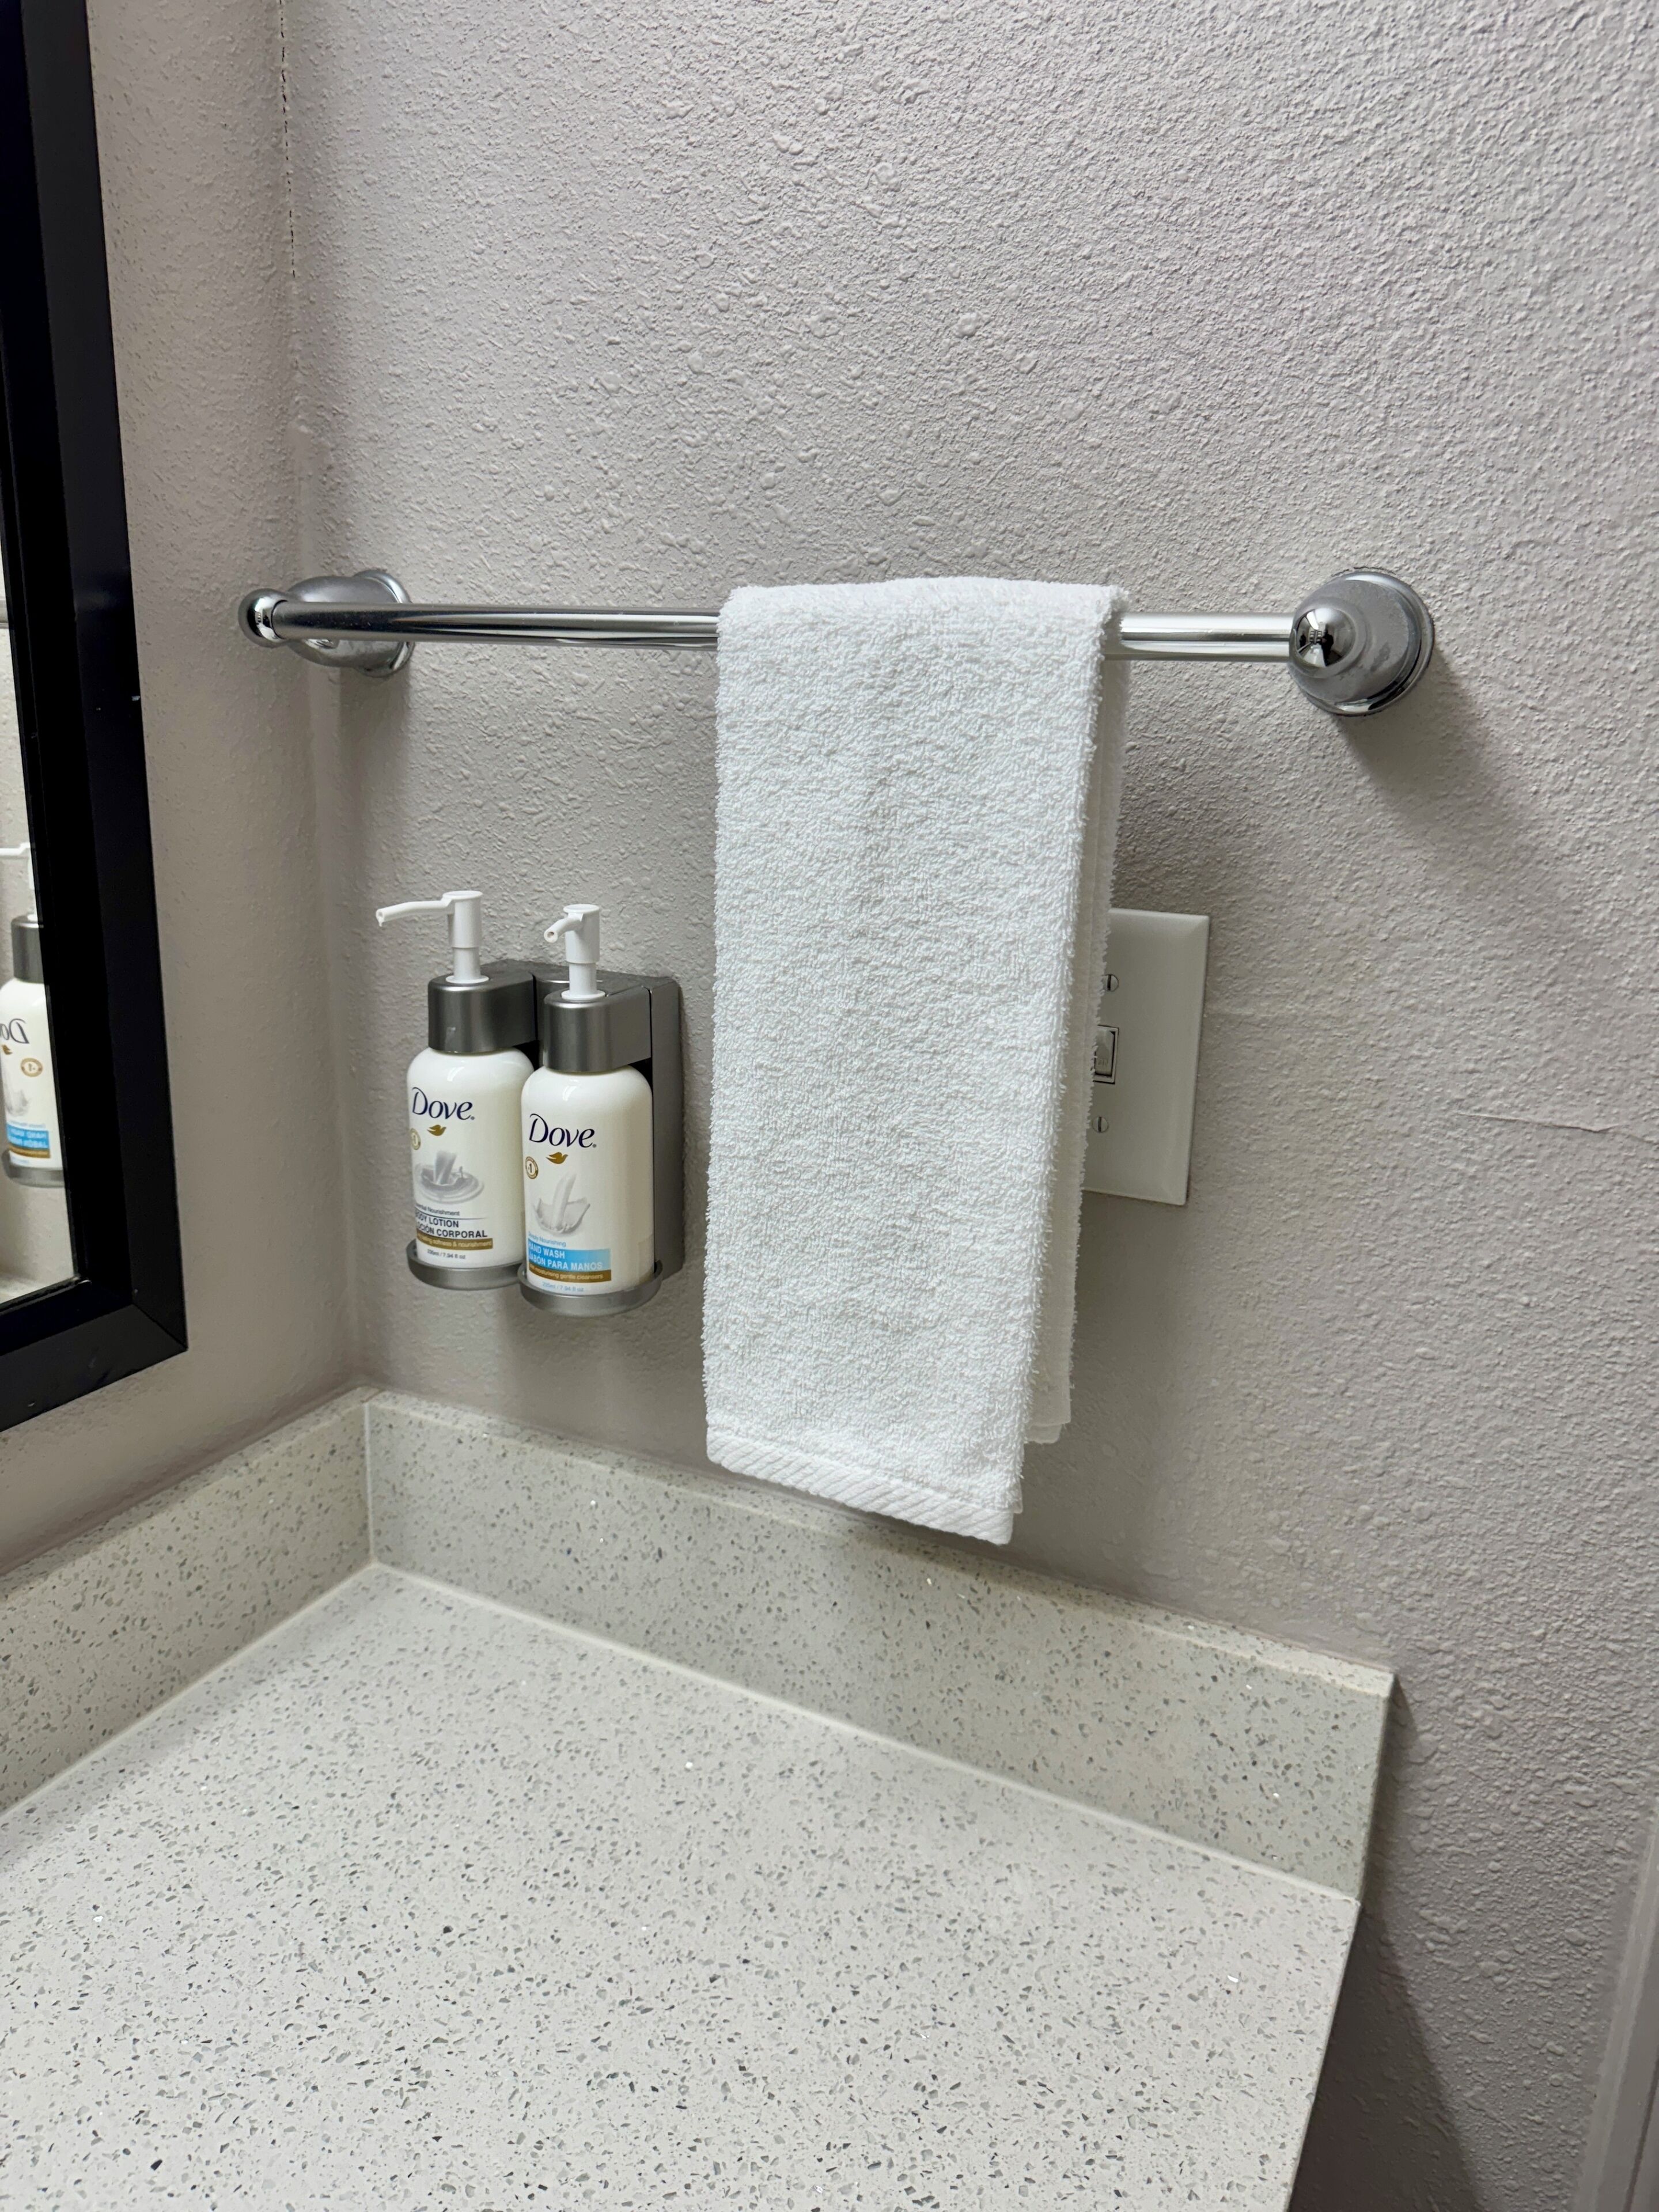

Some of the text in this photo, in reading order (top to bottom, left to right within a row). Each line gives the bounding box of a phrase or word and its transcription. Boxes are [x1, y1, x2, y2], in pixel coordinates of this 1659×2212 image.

[412, 1087, 473, 1120] Dove
[529, 1113, 595, 1148] Dove
[429, 1217, 459, 1228] LOTION
[437, 1228, 488, 1238] CORPORAL
[529, 1241, 565, 1259] HAND WASH
[547, 1258, 569, 1270] PARA
[571, 1262, 603, 1271] MANOS
